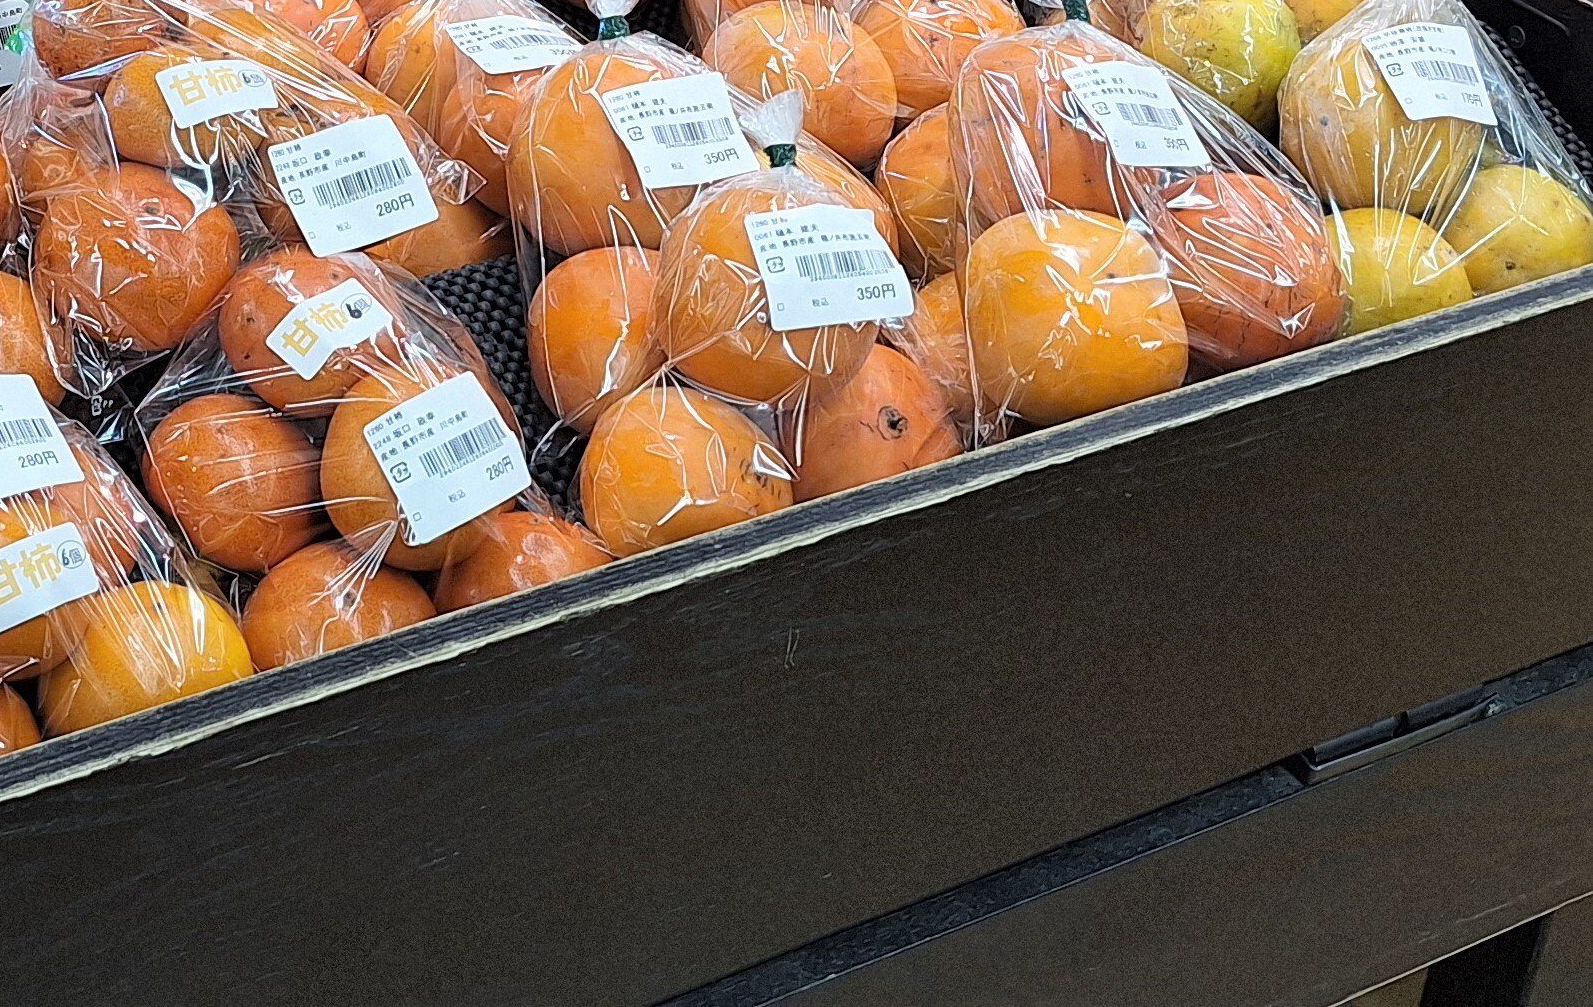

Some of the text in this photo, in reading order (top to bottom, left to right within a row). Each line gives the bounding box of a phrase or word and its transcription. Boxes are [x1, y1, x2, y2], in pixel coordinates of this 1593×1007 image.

[169, 67, 241, 106] 甘柿
[703, 148, 739, 164] 350円
[376, 193, 415, 217] 280円
[857, 283, 895, 300] 350円
[282, 302, 348, 357] 甘柿
[18, 450, 59, 468] 280円
[486, 455, 514, 480] 280円
